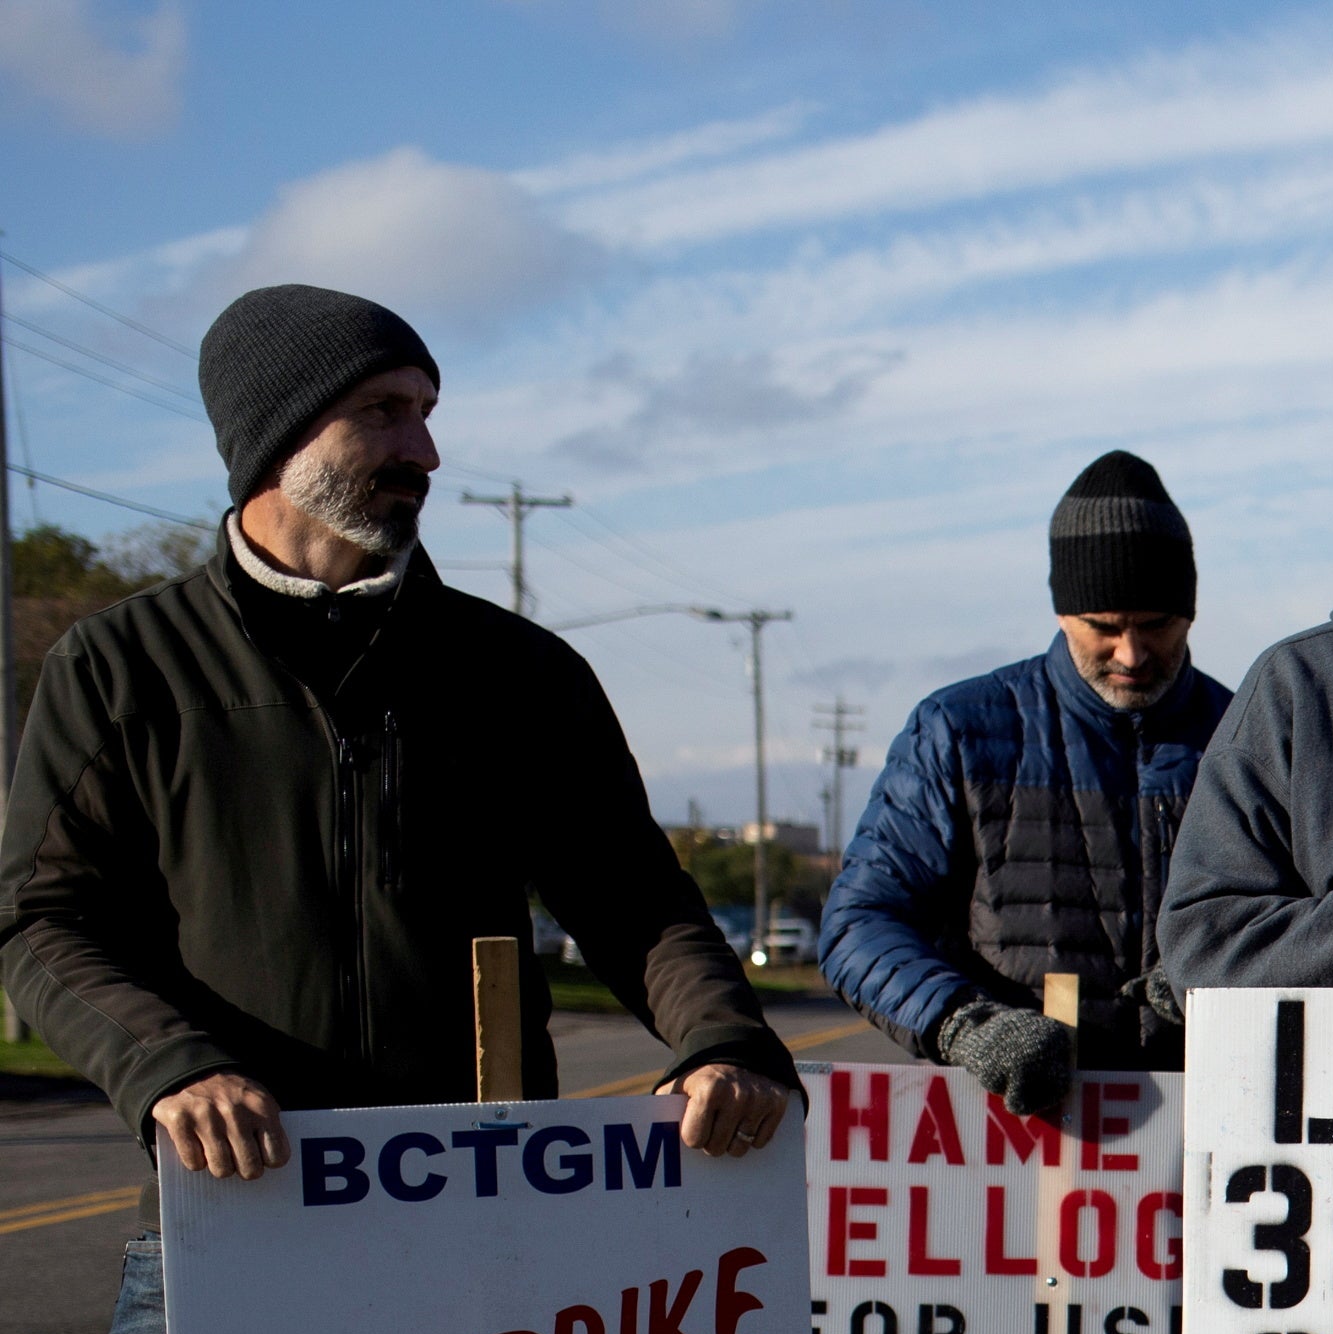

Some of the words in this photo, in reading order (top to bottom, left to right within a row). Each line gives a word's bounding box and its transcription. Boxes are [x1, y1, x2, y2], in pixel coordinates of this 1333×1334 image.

[300, 1120, 682, 1207] BCTGM
[829, 1071, 1140, 1171] HAME
[826, 1184, 1183, 1281] ELLOG
